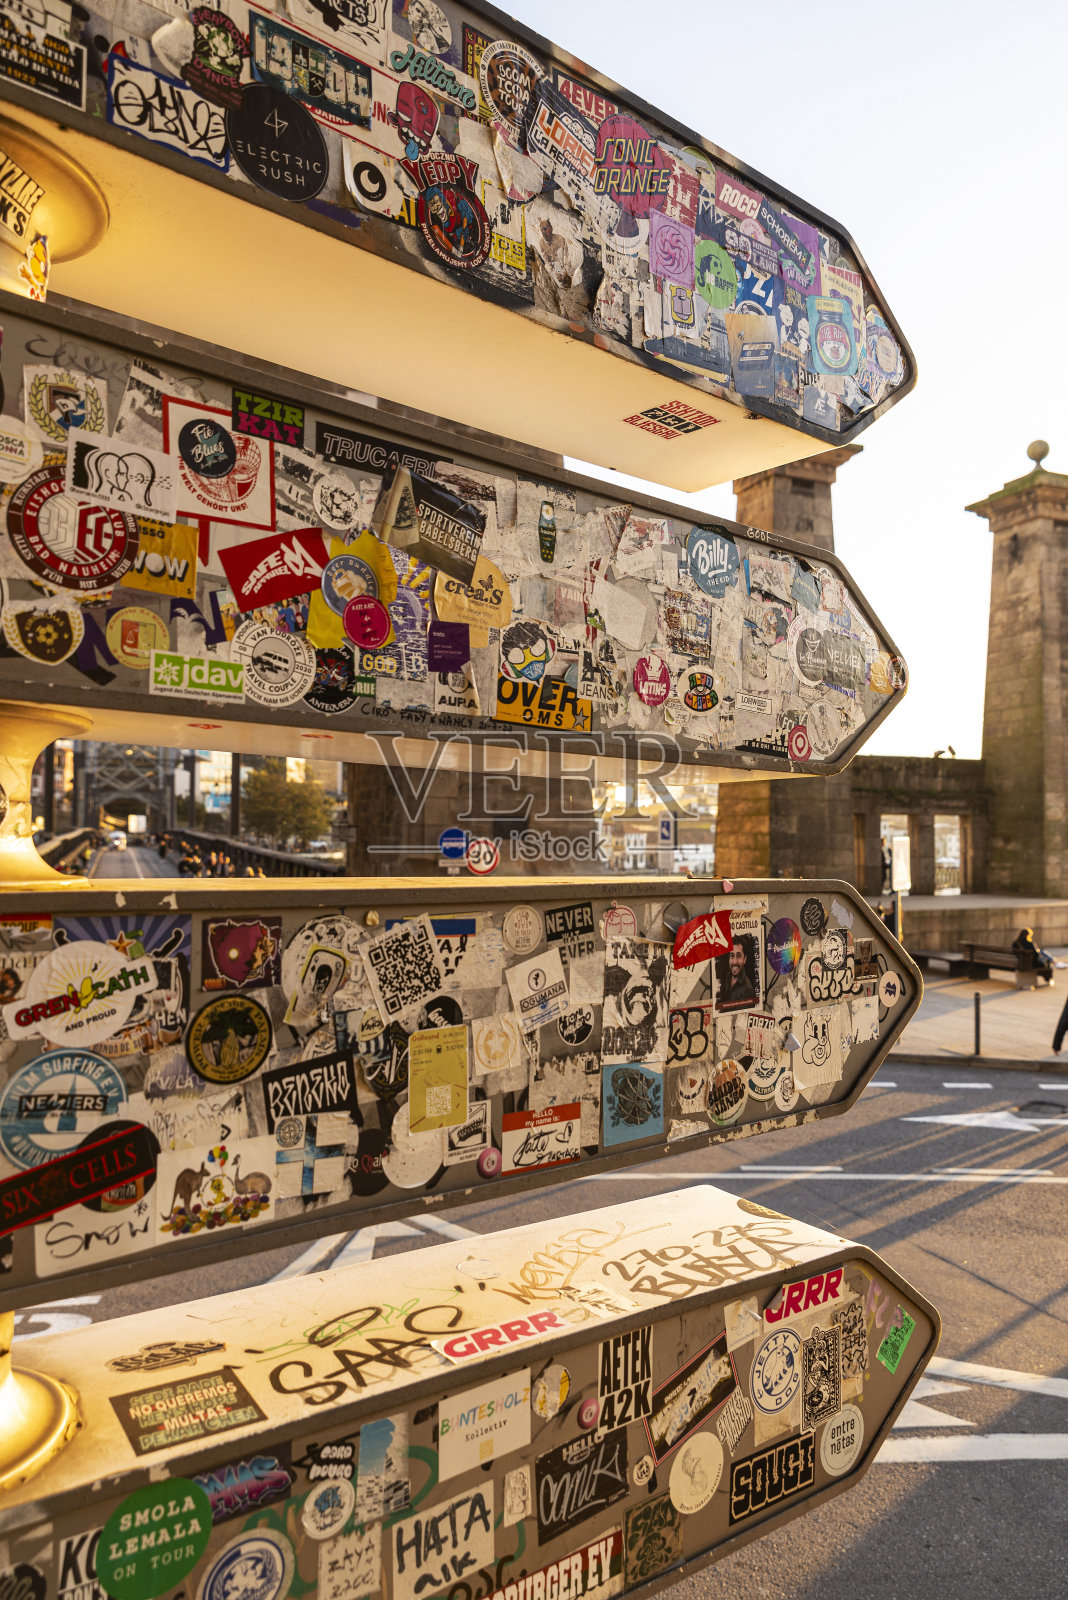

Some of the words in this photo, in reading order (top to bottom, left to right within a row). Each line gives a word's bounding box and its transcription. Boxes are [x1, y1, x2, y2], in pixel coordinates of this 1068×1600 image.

[193, 57, 239, 89] DANCE
[390, 44, 476, 110] Hiltown
[236, 140, 323, 174] ELECTRIC
[595, 138, 657, 164] SONIC
[259, 163, 306, 187] RUSH
[400, 155, 479, 193] YEOPY
[594, 168, 671, 195] ORANGE
[234, 390, 304, 428] TZIR
[238, 411, 301, 446] KAT
[191, 440, 225, 463] Blues
[181, 472, 198, 494] WELT
[196, 493, 228, 512] GEHÖRT
[28, 535, 50, 560] BAD
[420, 519, 478, 561] BABELSBERG
[241, 550, 281, 596] SAFE
[251, 631, 267, 642] VAN
[183, 658, 244, 688] jdav
[269, 677, 297, 693] COUPLE
[580, 683, 614, 698] JEANS
[545, 906, 593, 934] NEVER
[735, 920, 759, 930] CASTILLO
[676, 924, 704, 958] SAFE
[65, 1021, 84, 1032] AND
[86, 1008, 117, 1025] PROUD
[42, 1057, 105, 1080] SURFING
[532, 1108, 553, 1119] HELLO
[535, 1117, 552, 1125] name
[1, 1184, 42, 1219] SIX
[69, 1143, 138, 1190] CELLS
[443, 1310, 566, 1359] GRRR
[755, 1334, 790, 1378] JETTY
[128, 1403, 154, 1420] NO
[155, 1381, 238, 1412] QUEREMOS
[600, 1381, 651, 1431] 42K
[775, 1372, 800, 1407] DOG
[163, 1404, 229, 1432] MULTAS
[440, 1387, 530, 1436] BUNTESHOLZ
[465, 1418, 508, 1443] Kollektiv
[831, 1418, 855, 1440] entre
[119, 1496, 196, 1532] SMOLA
[108, 1518, 202, 1561] LEMALA
[113, 1562, 137, 1582] ON
[150, 1543, 196, 1570] TOUR
